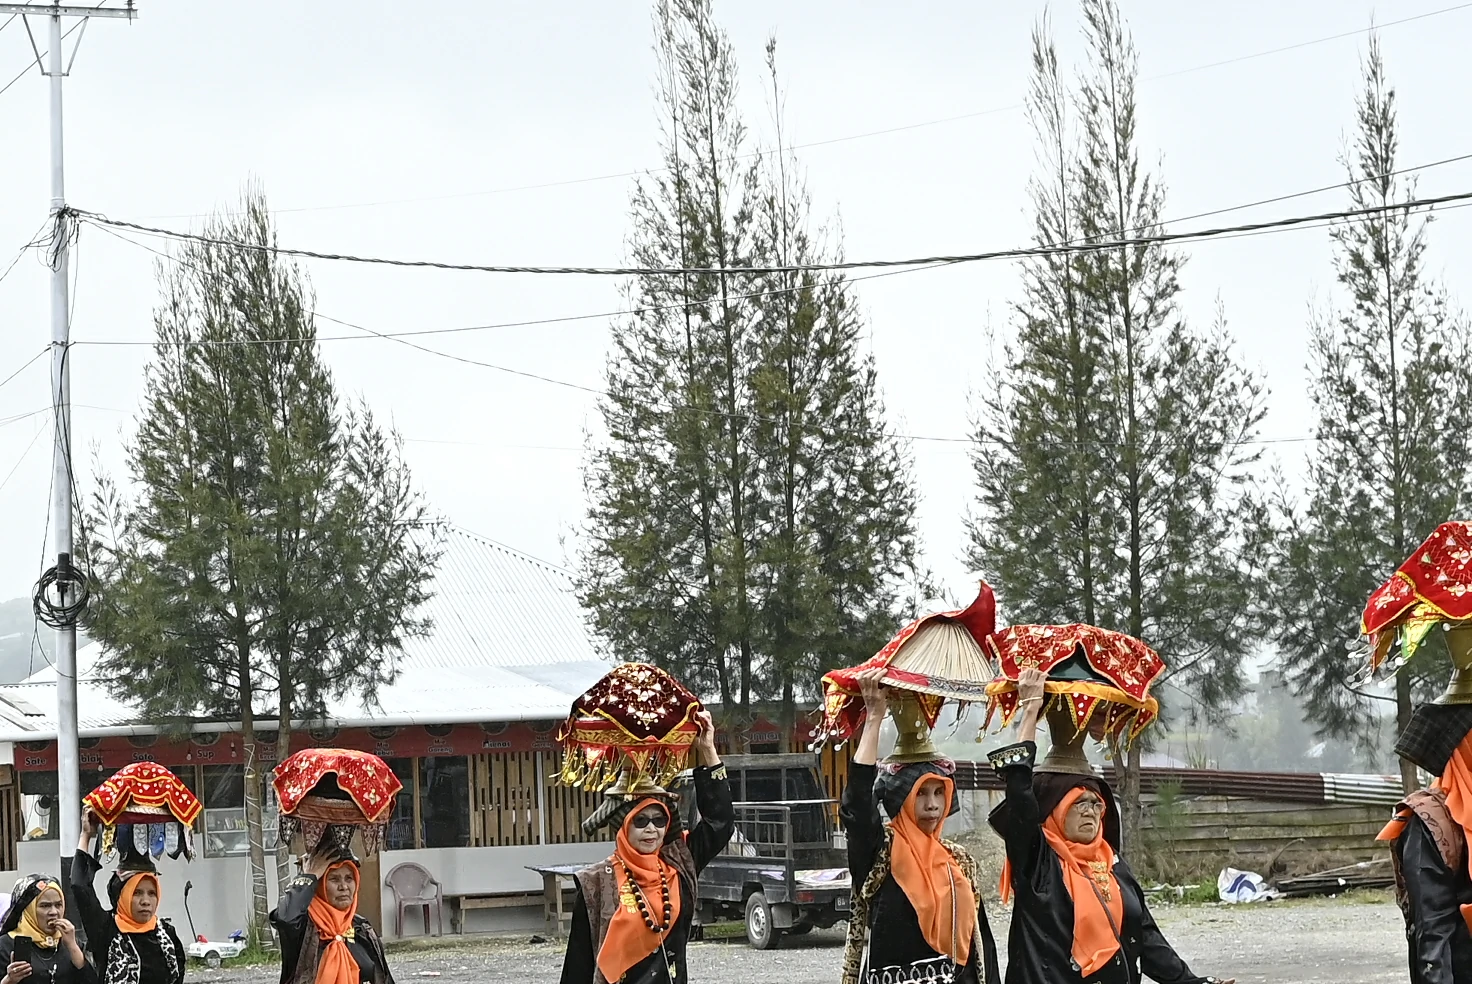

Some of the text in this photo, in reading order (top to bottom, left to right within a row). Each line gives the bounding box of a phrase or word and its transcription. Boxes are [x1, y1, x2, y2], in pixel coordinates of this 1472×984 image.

[197, 750, 215, 761] Sup
[428, 746, 454, 755] Goreng
[132, 752, 154, 762] Soto
